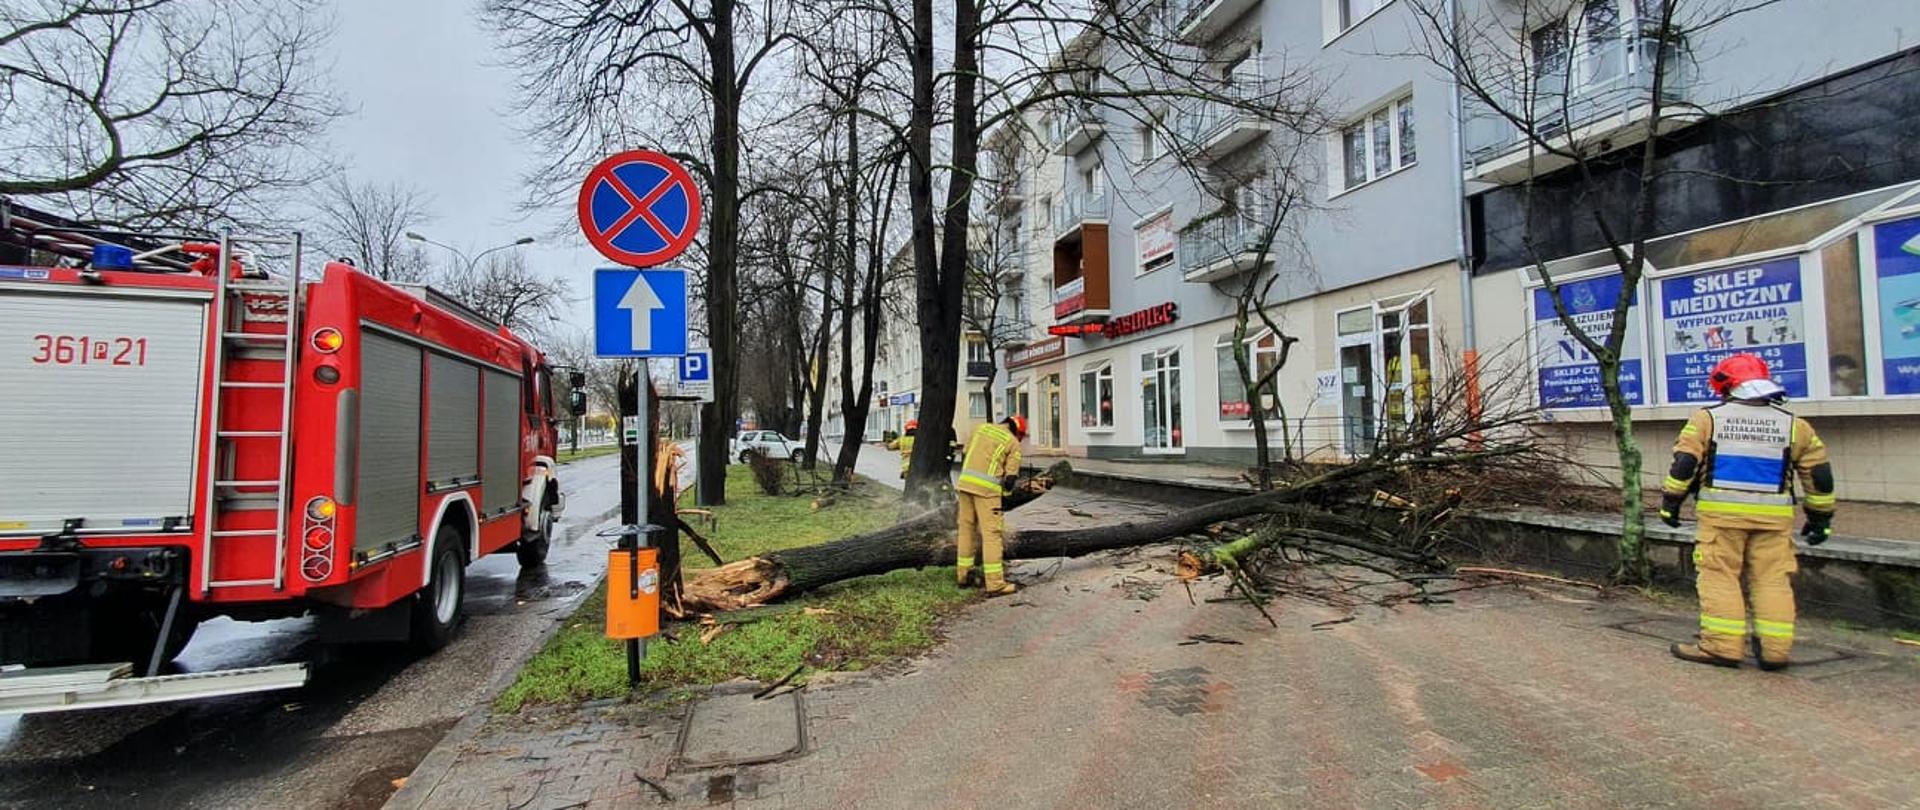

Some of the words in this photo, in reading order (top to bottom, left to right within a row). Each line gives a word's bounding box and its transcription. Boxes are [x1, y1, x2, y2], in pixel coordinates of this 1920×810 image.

[1693, 269, 1763, 293] SKLEP
[1670, 283, 1792, 316] MEDYCZNY
[32, 335, 89, 364] 361
[113, 338, 146, 365] 21
[1764, 348, 1781, 357] 43
[685, 355, 701, 378] P
[1553, 368, 1580, 377] SKLEP
